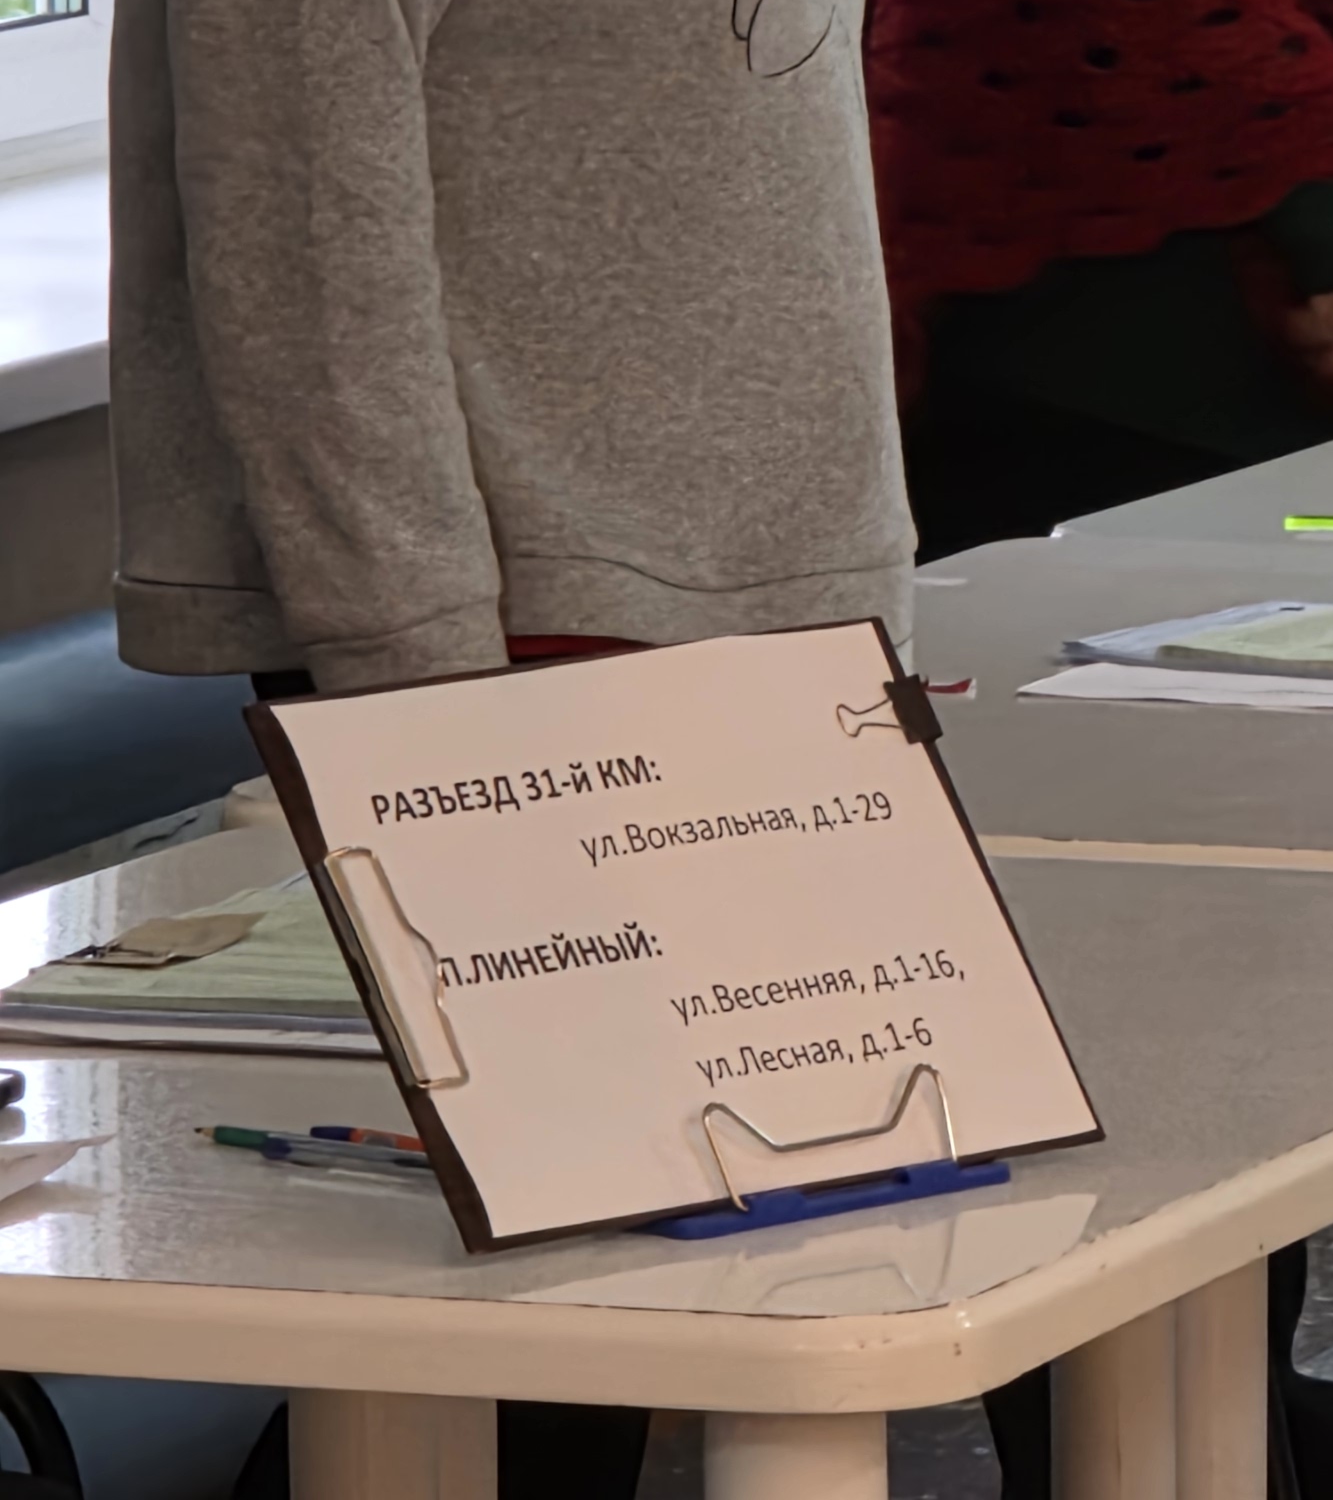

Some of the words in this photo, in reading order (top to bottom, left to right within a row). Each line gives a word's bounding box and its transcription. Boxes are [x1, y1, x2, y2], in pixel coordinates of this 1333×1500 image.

[370, 775, 521, 826] РАЗЪЕЗД
[521, 761, 594, 802] 31-й
[595, 754, 663, 790] КМ:
[579, 807, 807, 868] ул.Вокзальная,
[811, 790, 893, 833] д.1-29
[438, 920, 664, 989] П.ЛИНЕЙНЫЙ:
[669, 968, 866, 1027] ул.Весенняя,
[872, 948, 965, 994] д.1-16,
[695, 1038, 854, 1089] ул.Лесная,
[860, 1016, 933, 1063] д.1-6
